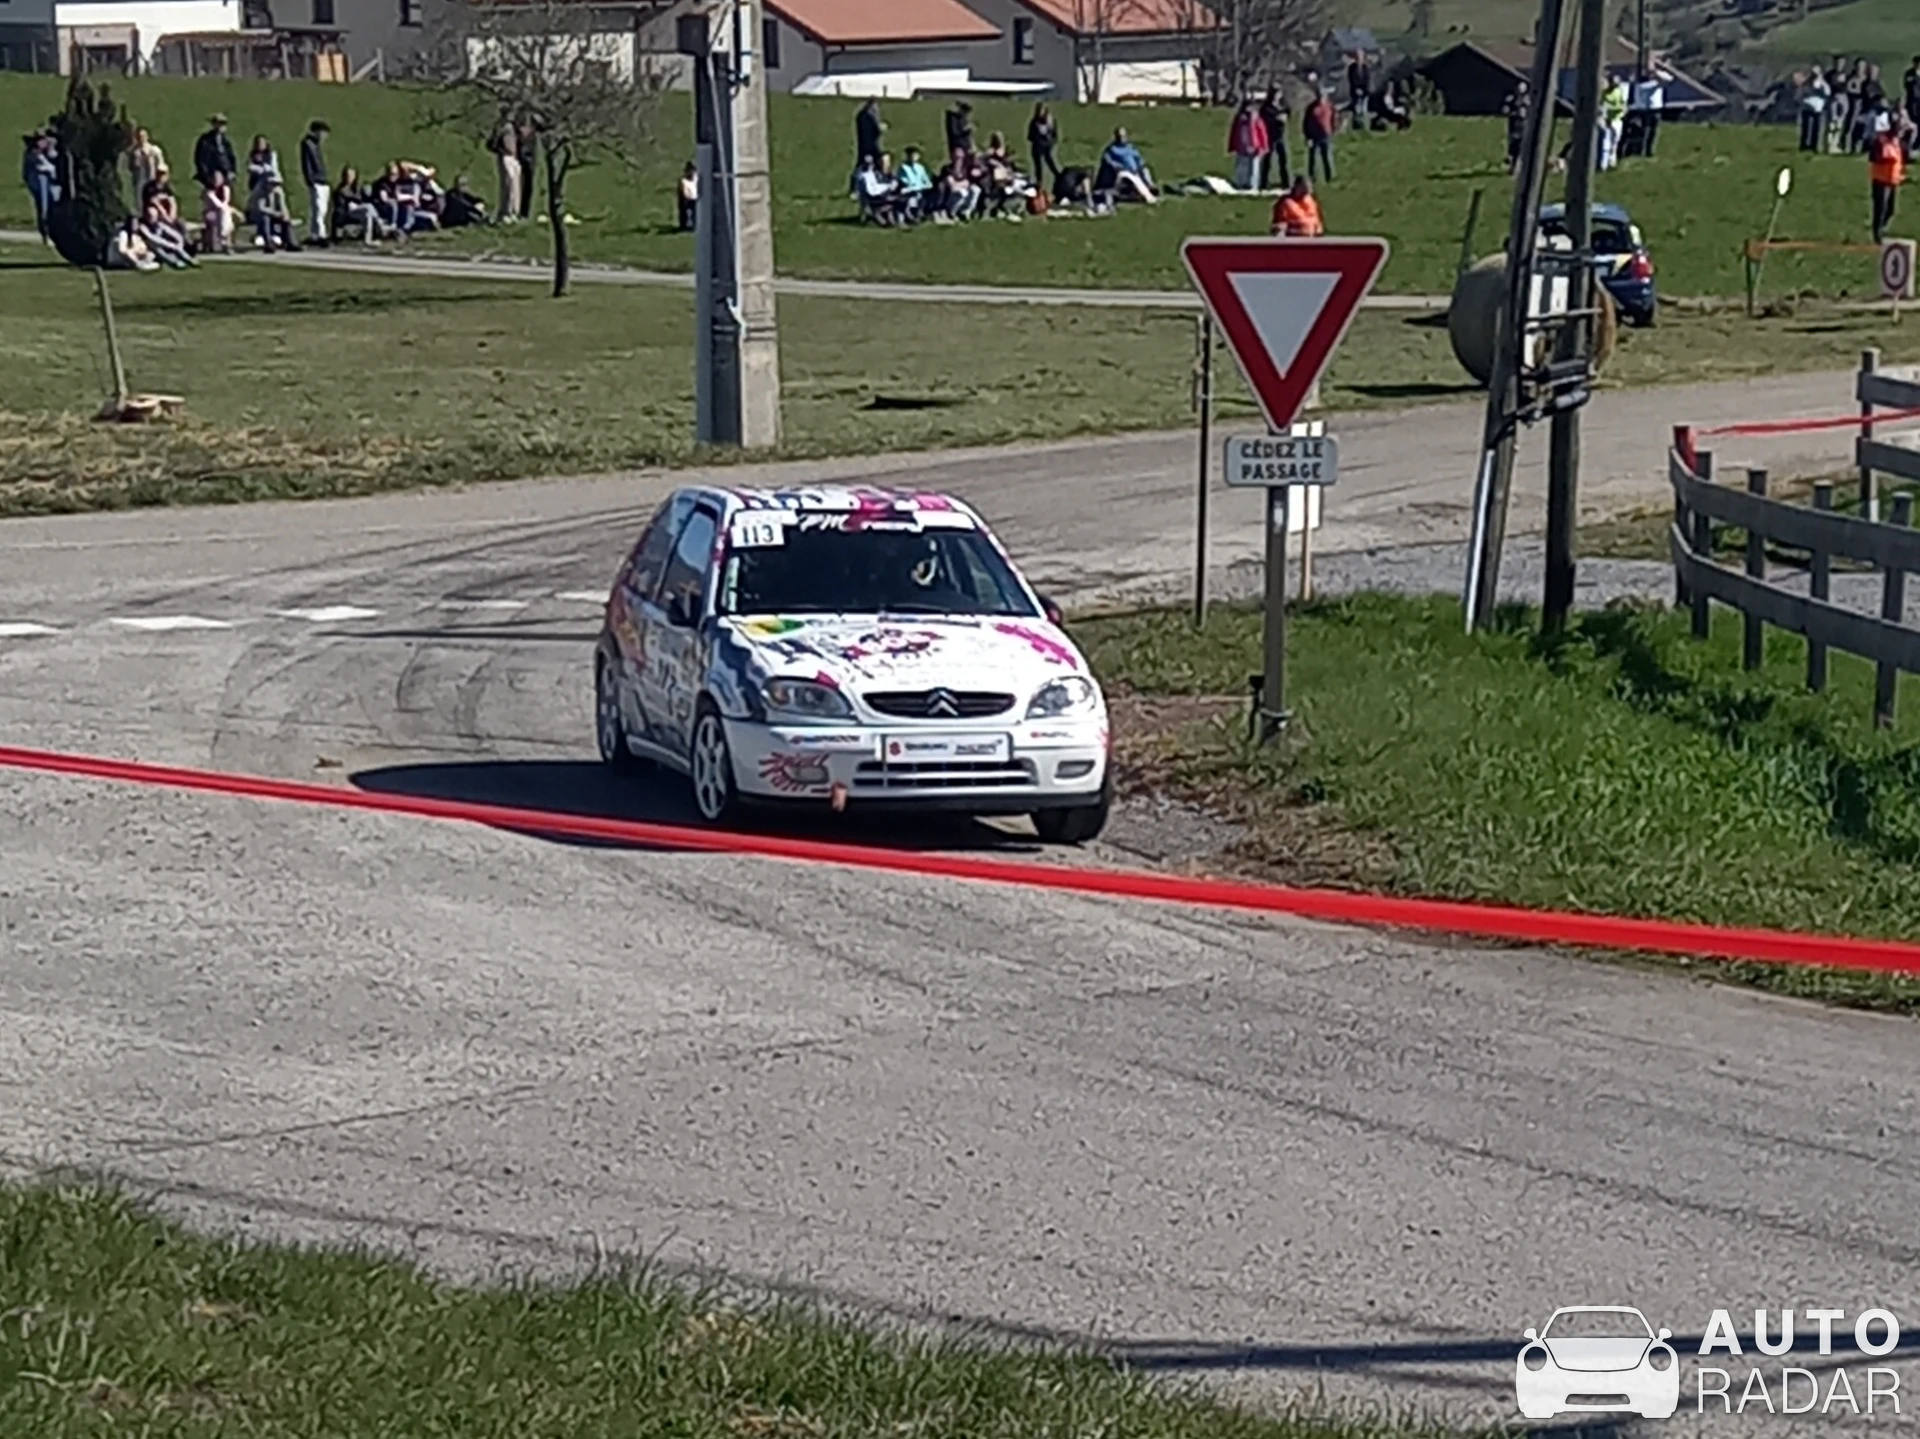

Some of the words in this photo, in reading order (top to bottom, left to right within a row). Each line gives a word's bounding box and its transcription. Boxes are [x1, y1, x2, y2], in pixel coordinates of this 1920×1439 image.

[1240, 438, 1297, 459] CÉDEZ
[1302, 442, 1324, 459] LE
[1240, 462, 1323, 480] PASSAGE
[742, 524, 774, 544] 113
